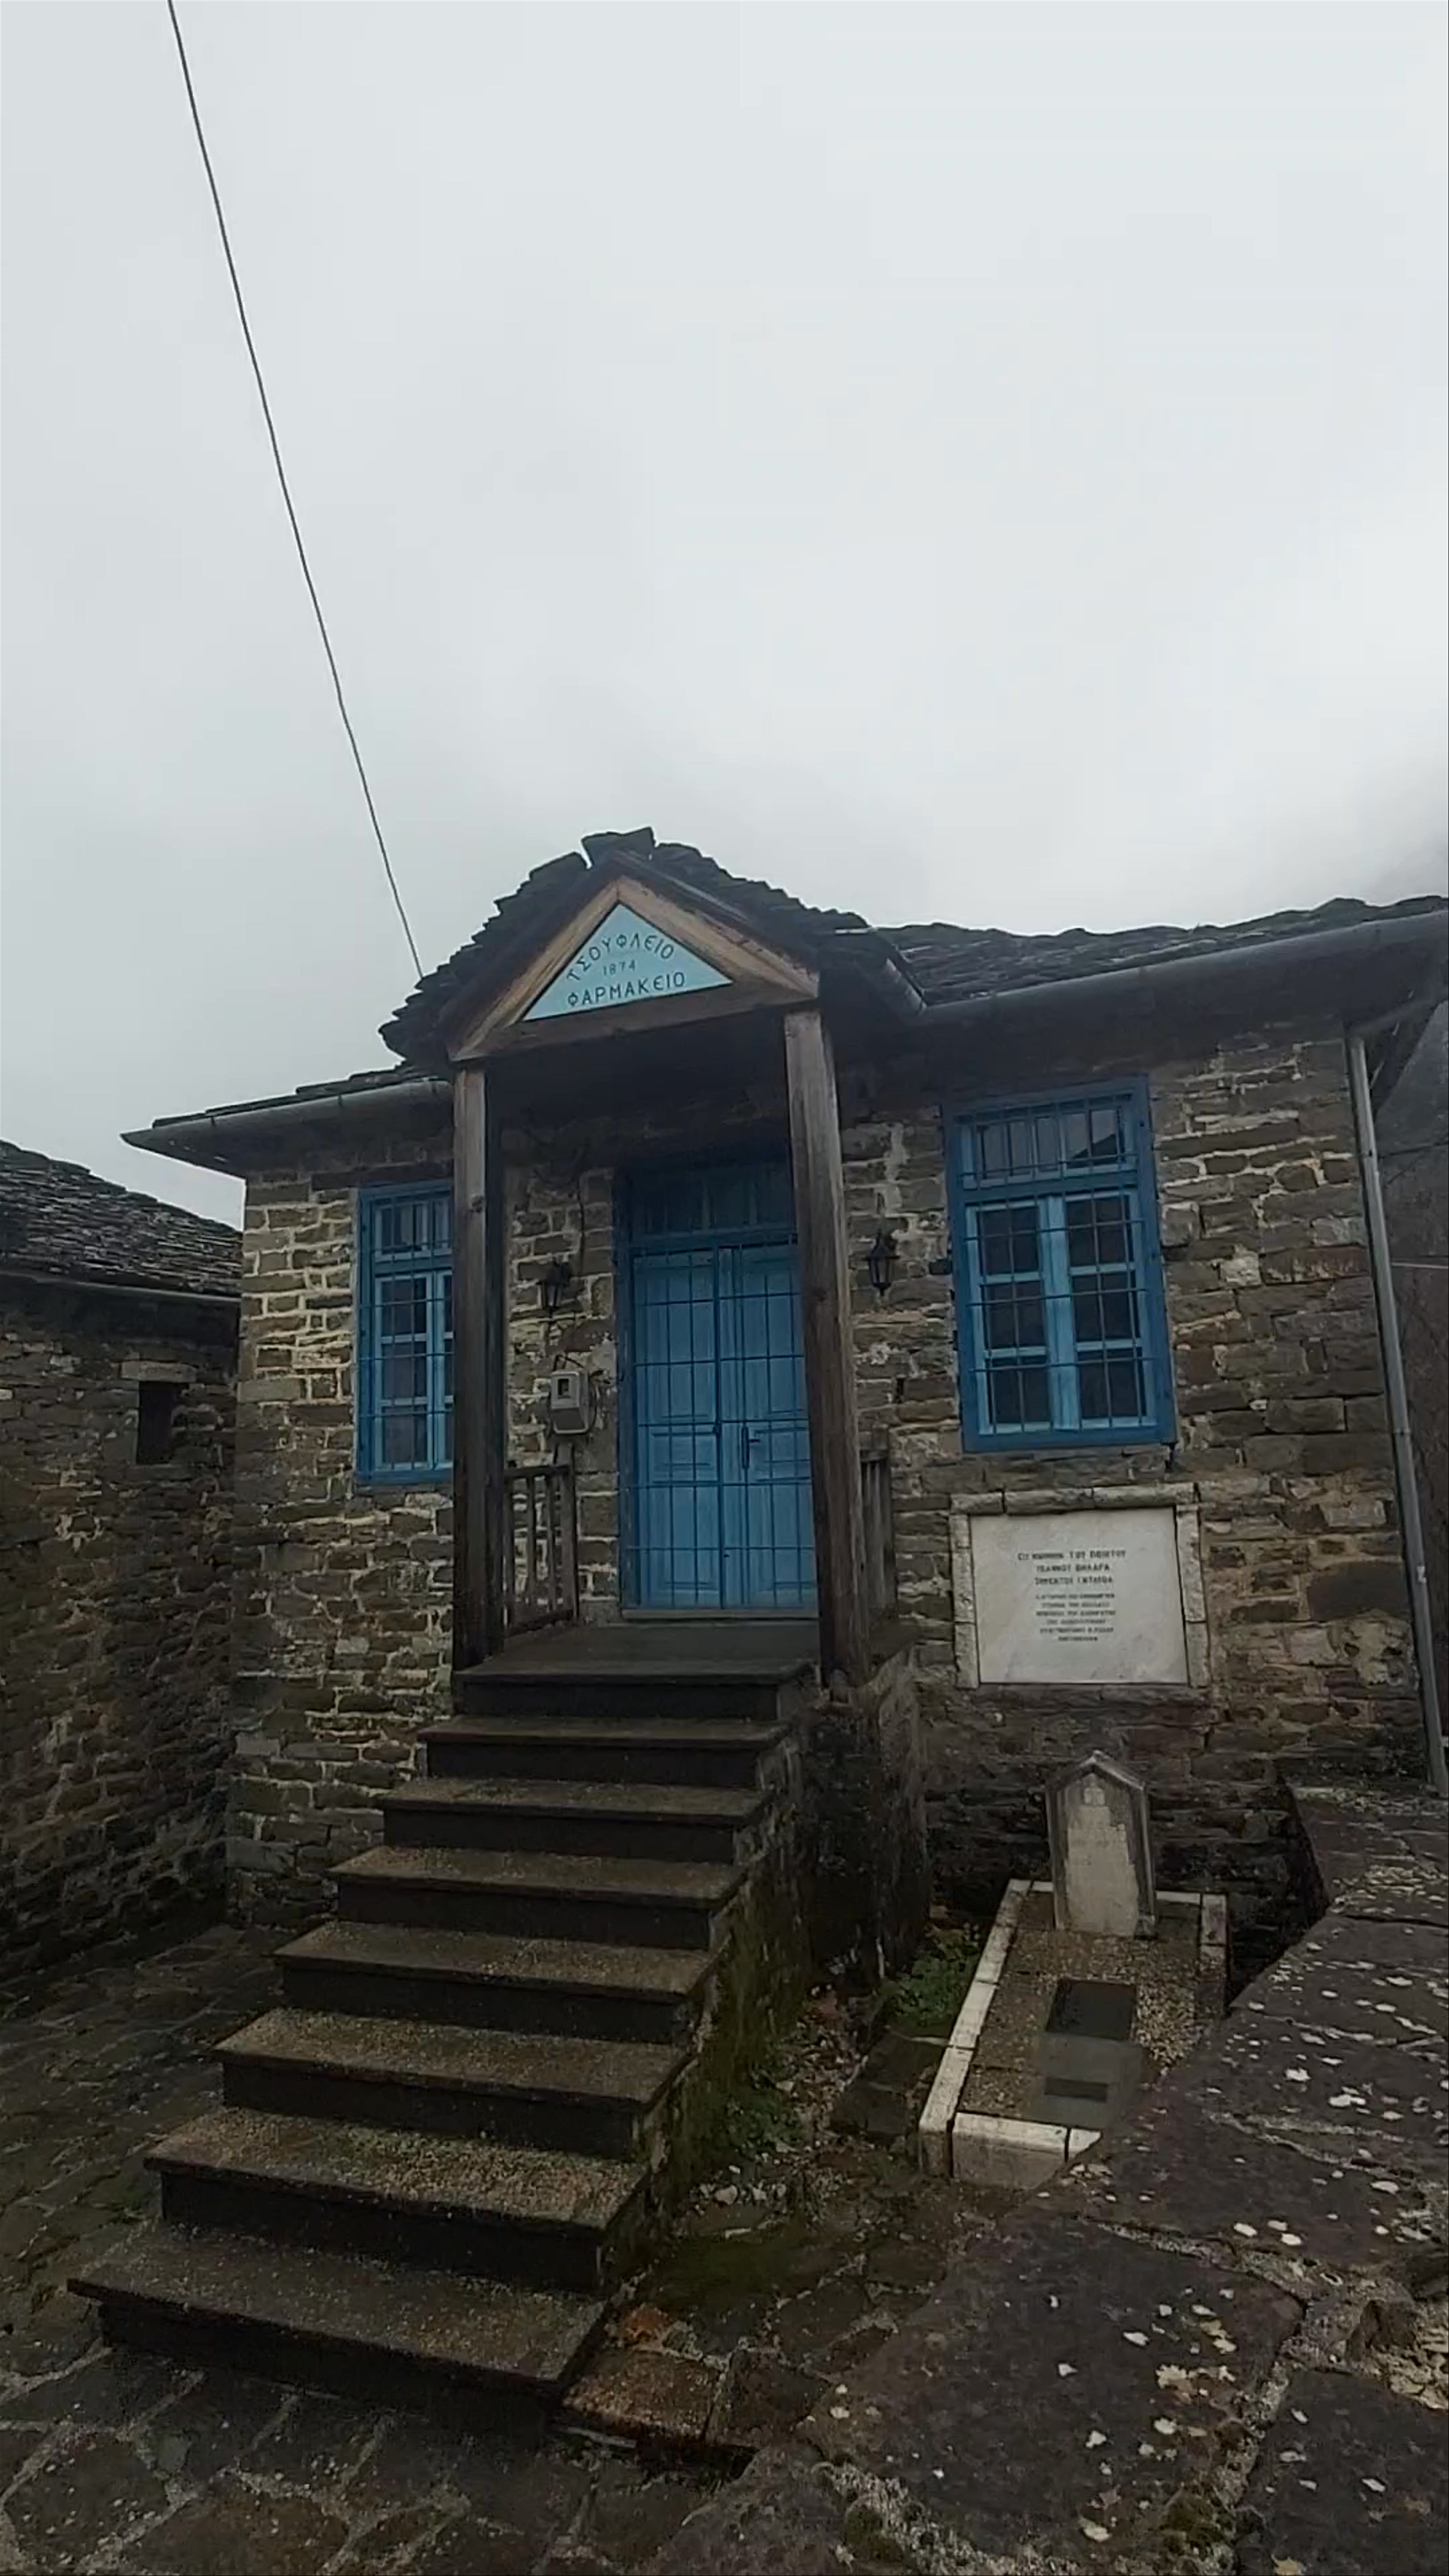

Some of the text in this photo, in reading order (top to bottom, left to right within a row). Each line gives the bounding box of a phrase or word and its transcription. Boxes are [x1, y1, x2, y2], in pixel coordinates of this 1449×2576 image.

[567, 933, 674, 981] ΤΣΟΥΦΛΕΙΟ
[603, 960, 636, 977] 1874
[568, 972, 685, 1007] ΦΑΡΜΑΚΕΙΟ
